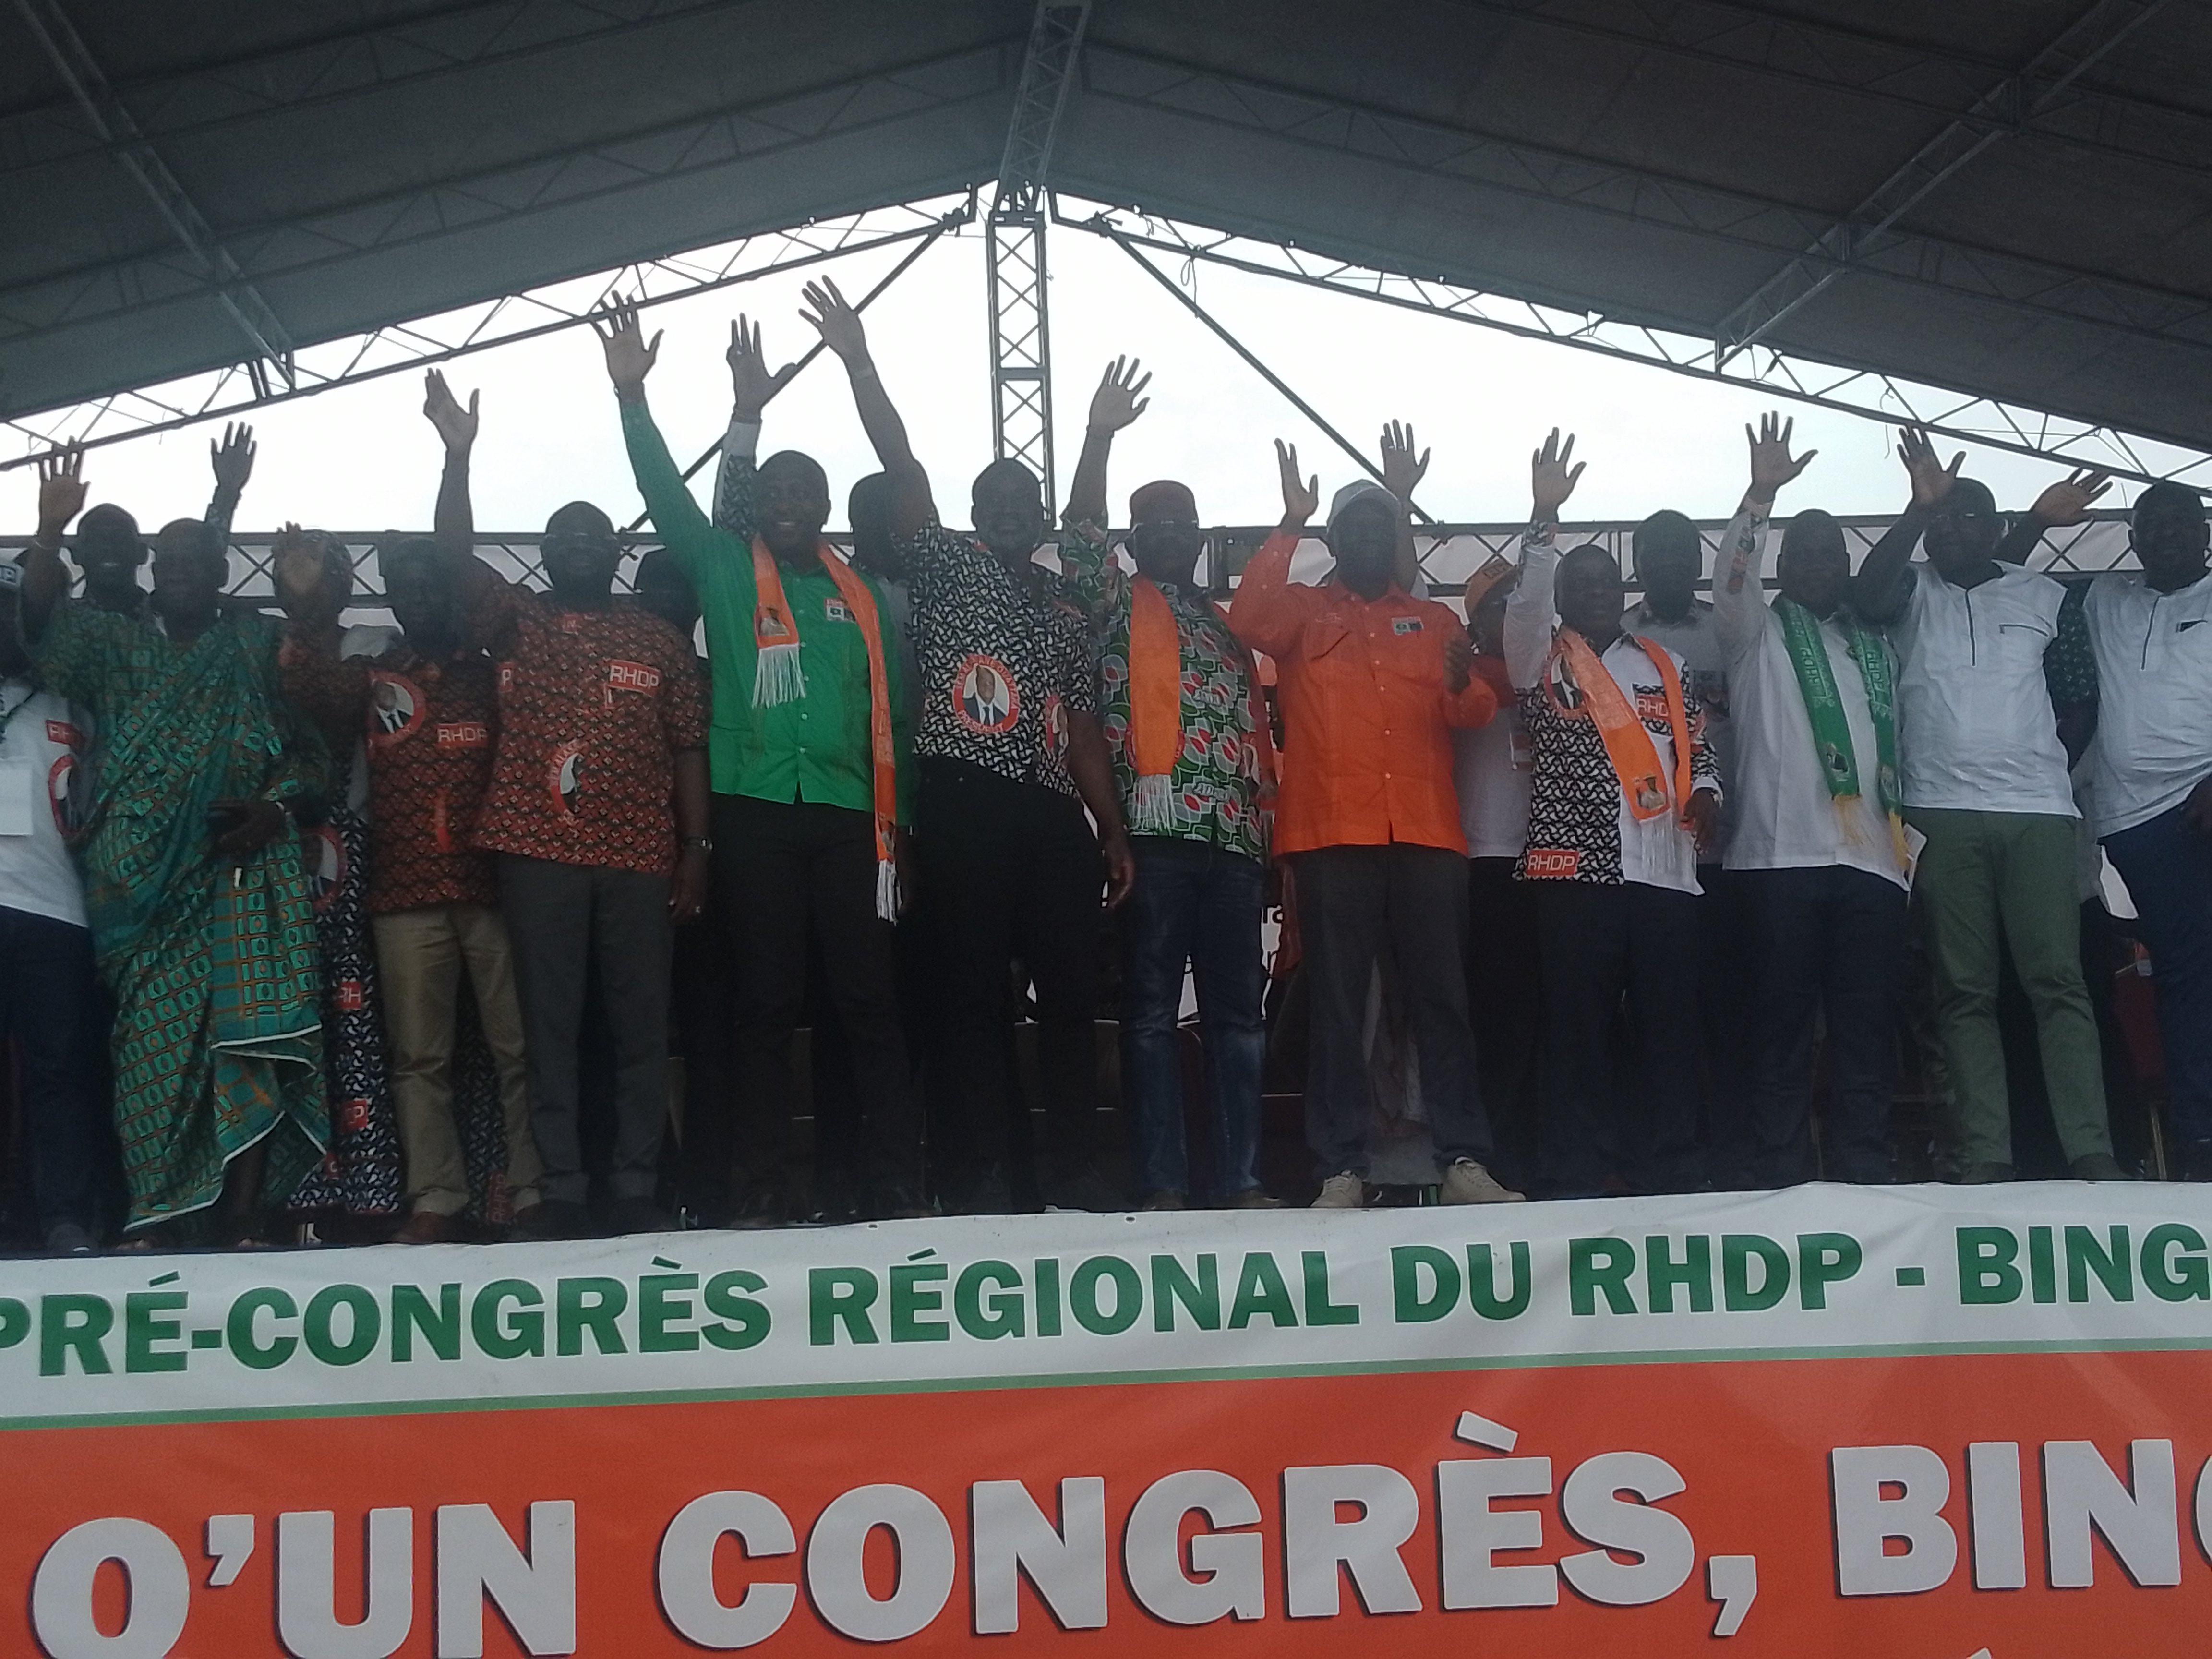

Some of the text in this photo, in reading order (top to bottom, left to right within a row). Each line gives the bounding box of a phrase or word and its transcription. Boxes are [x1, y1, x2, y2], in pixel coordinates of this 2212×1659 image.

[609, 665, 659, 688] RHDP
[1527, 854, 1575, 871] RHDP
[808, 1244, 1360, 1346] RÉGIONAL
[1390, 1241, 1531, 1323] DU
[1569, 1232, 1862, 1315] RHDP
[1897, 1268, 1925, 1286] -
[659, 1411, 1757, 1648] CONGRÈS,
[1831, 1439, 2212, 1596] BIN
